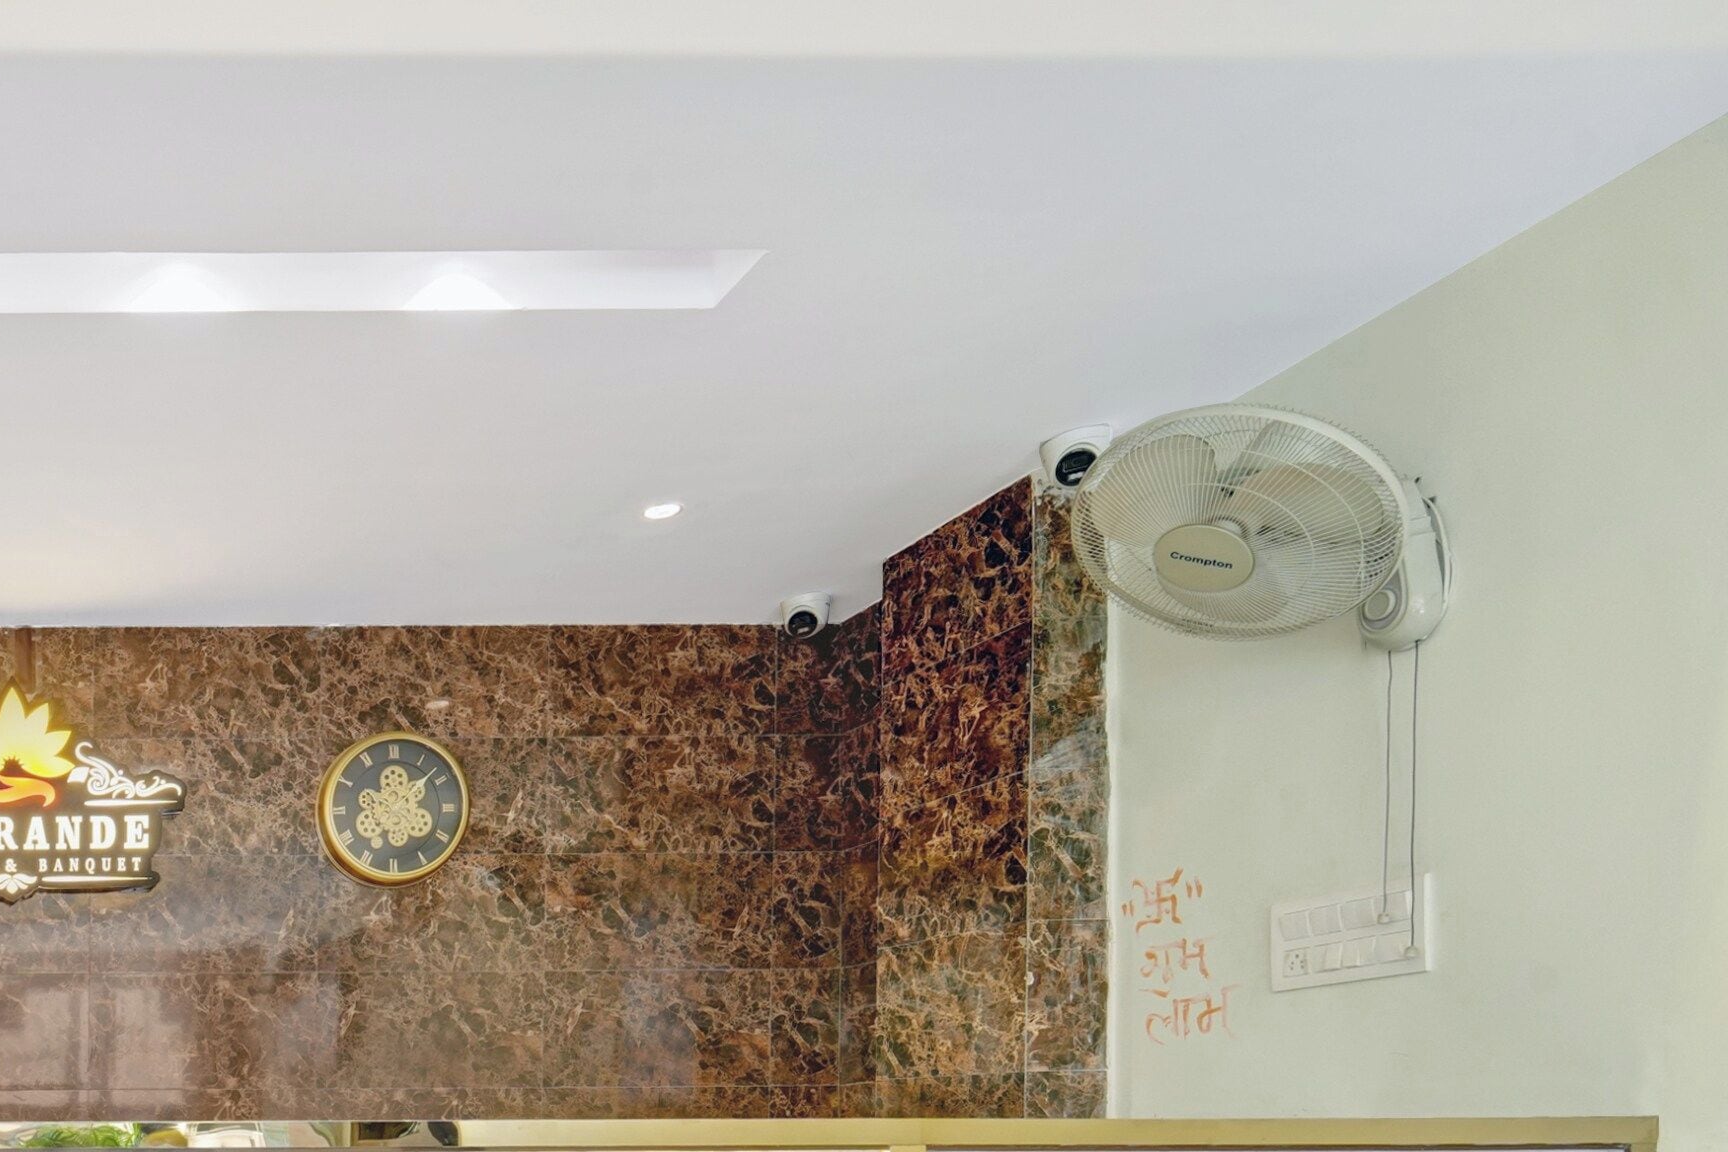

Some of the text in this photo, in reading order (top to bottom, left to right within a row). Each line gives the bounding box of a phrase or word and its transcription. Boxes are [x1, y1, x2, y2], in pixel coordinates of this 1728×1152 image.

[1170, 551, 1233, 569] Crompton
[388, 744, 399, 759] XII
[5, 858, 17, 873] &
[38, 857, 141, 873] BANQUET
